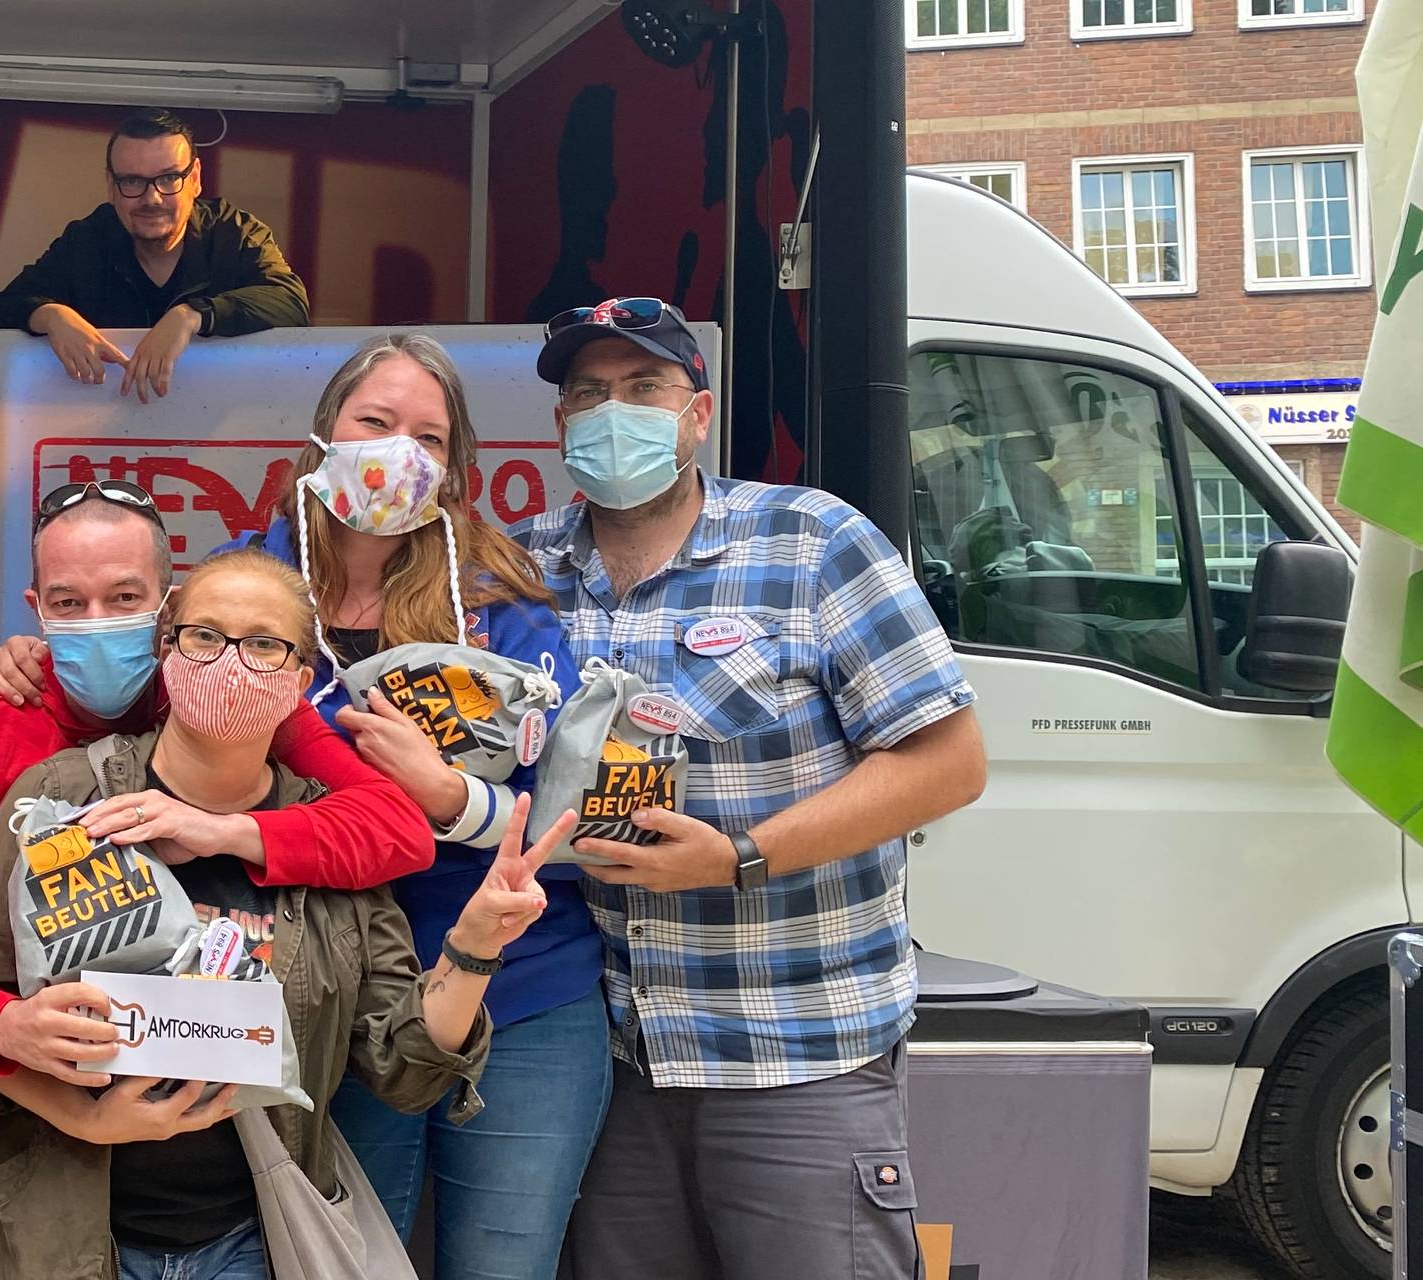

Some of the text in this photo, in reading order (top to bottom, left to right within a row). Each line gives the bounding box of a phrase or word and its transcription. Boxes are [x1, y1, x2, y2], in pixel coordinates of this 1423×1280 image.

[1268, 406, 1339, 424] Nüsser
[412, 674, 466, 747] FAN
[1032, 719, 1151, 730] PFD PRESSEFUNK GMBH
[584, 773, 673, 817] BEUTEL!
[605, 765, 667, 794] FAN
[35, 856, 156, 938] BEUTEL!
[40, 851, 123, 909] FAN
